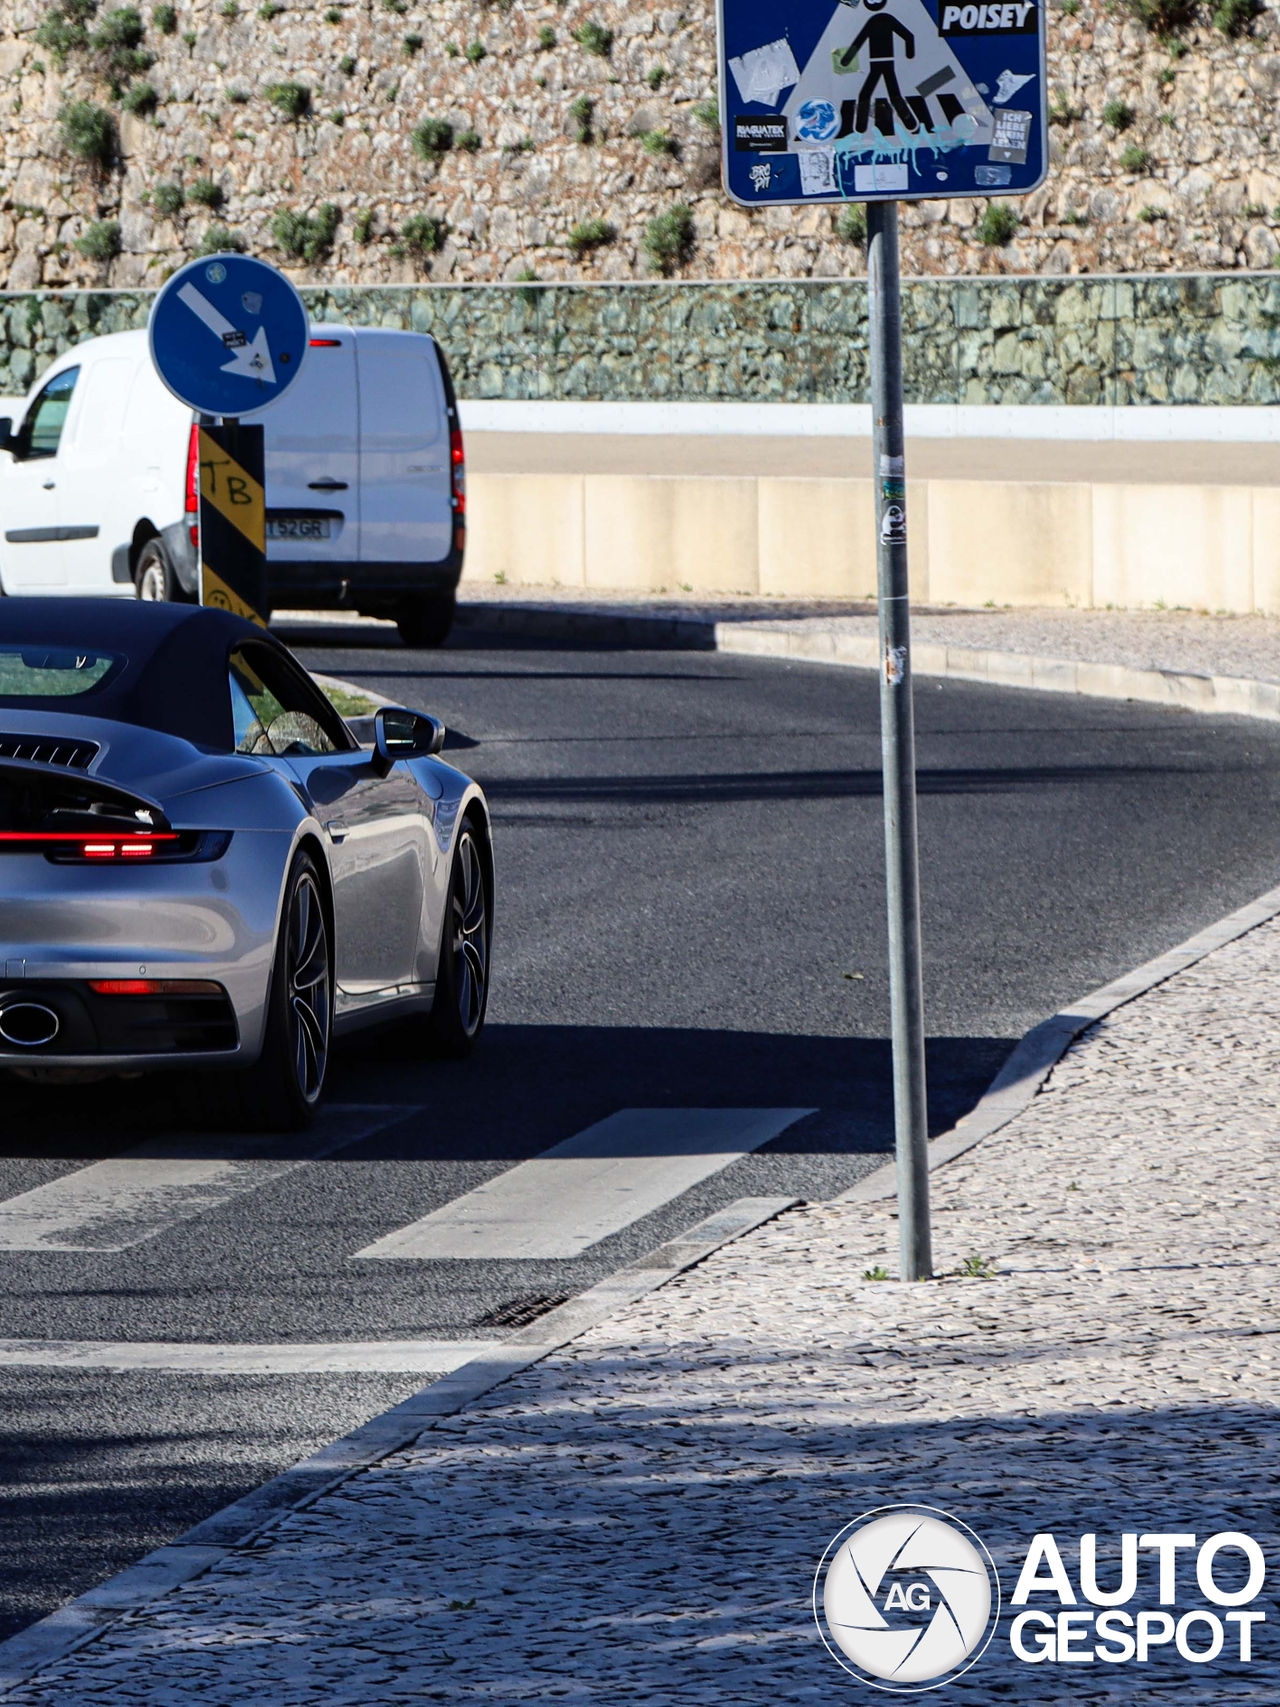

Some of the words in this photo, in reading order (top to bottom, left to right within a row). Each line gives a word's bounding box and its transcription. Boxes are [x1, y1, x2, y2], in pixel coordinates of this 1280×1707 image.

[942, 3, 1029, 30] POISEY
[1002, 112, 1021, 121] ICH
[996, 120, 1026, 132] LIEBE
